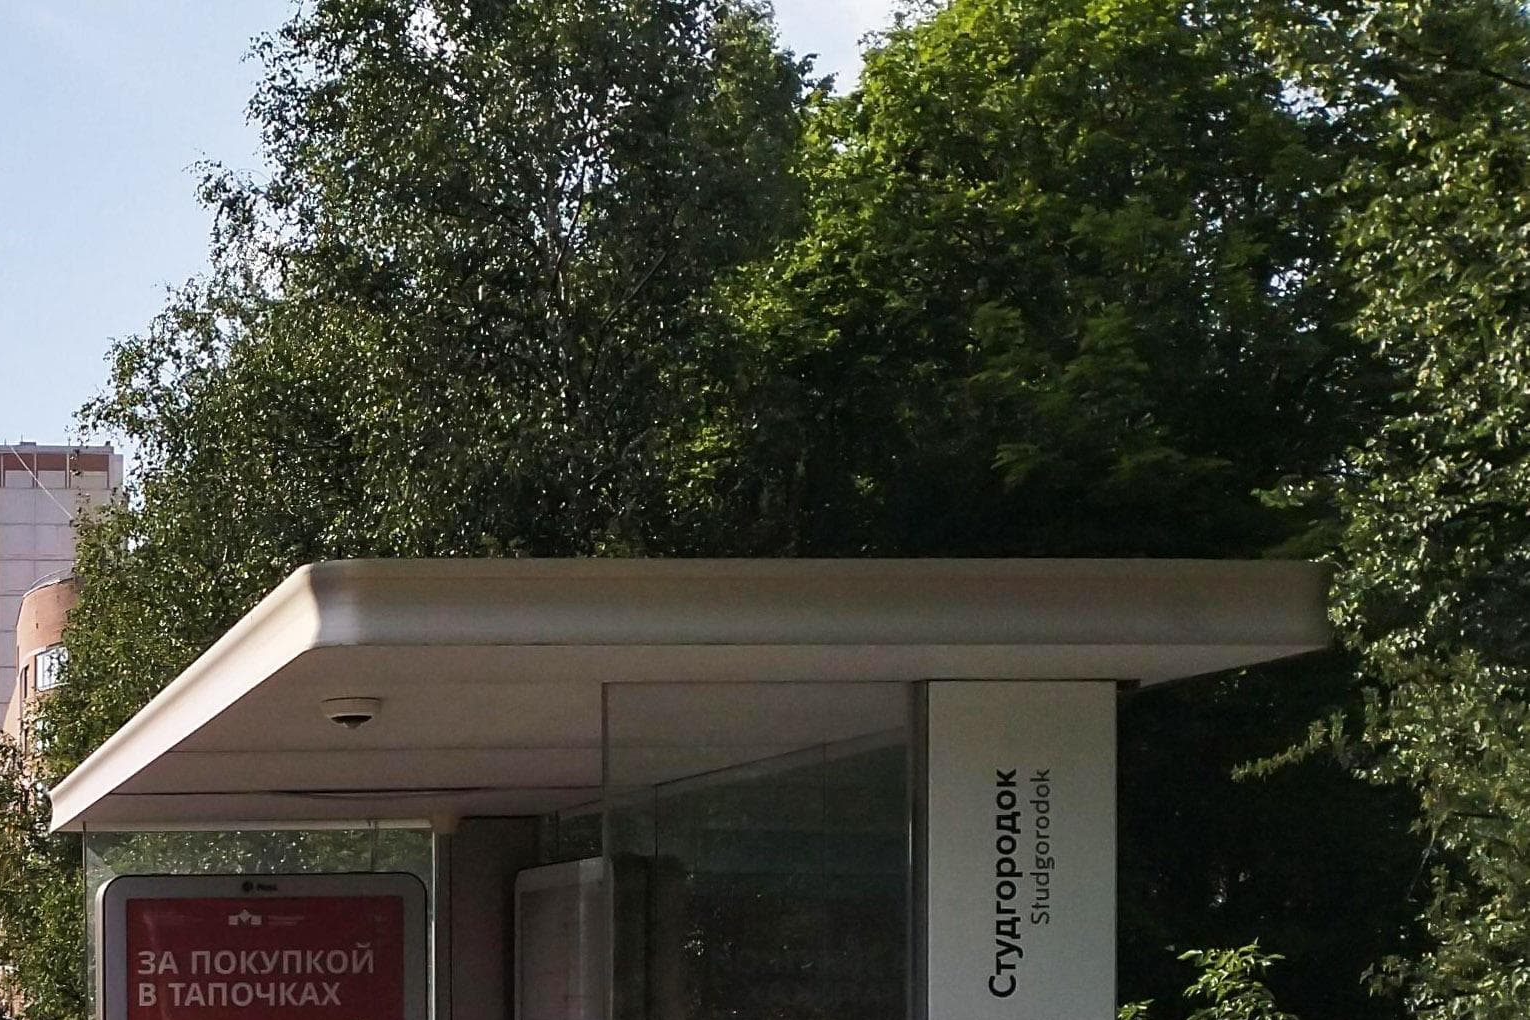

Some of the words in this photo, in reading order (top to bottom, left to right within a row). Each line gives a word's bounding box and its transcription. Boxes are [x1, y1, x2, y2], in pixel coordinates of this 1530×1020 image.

[987, 768, 1024, 999] Студгородок
[1029, 768, 1055, 925] Studgorodok
[138, 950, 179, 976] ЗА
[191, 942, 374, 976] ПОКУПКОЙ
[138, 982, 157, 1007] В
[168, 982, 342, 1007] ТАПОЧКАХ
